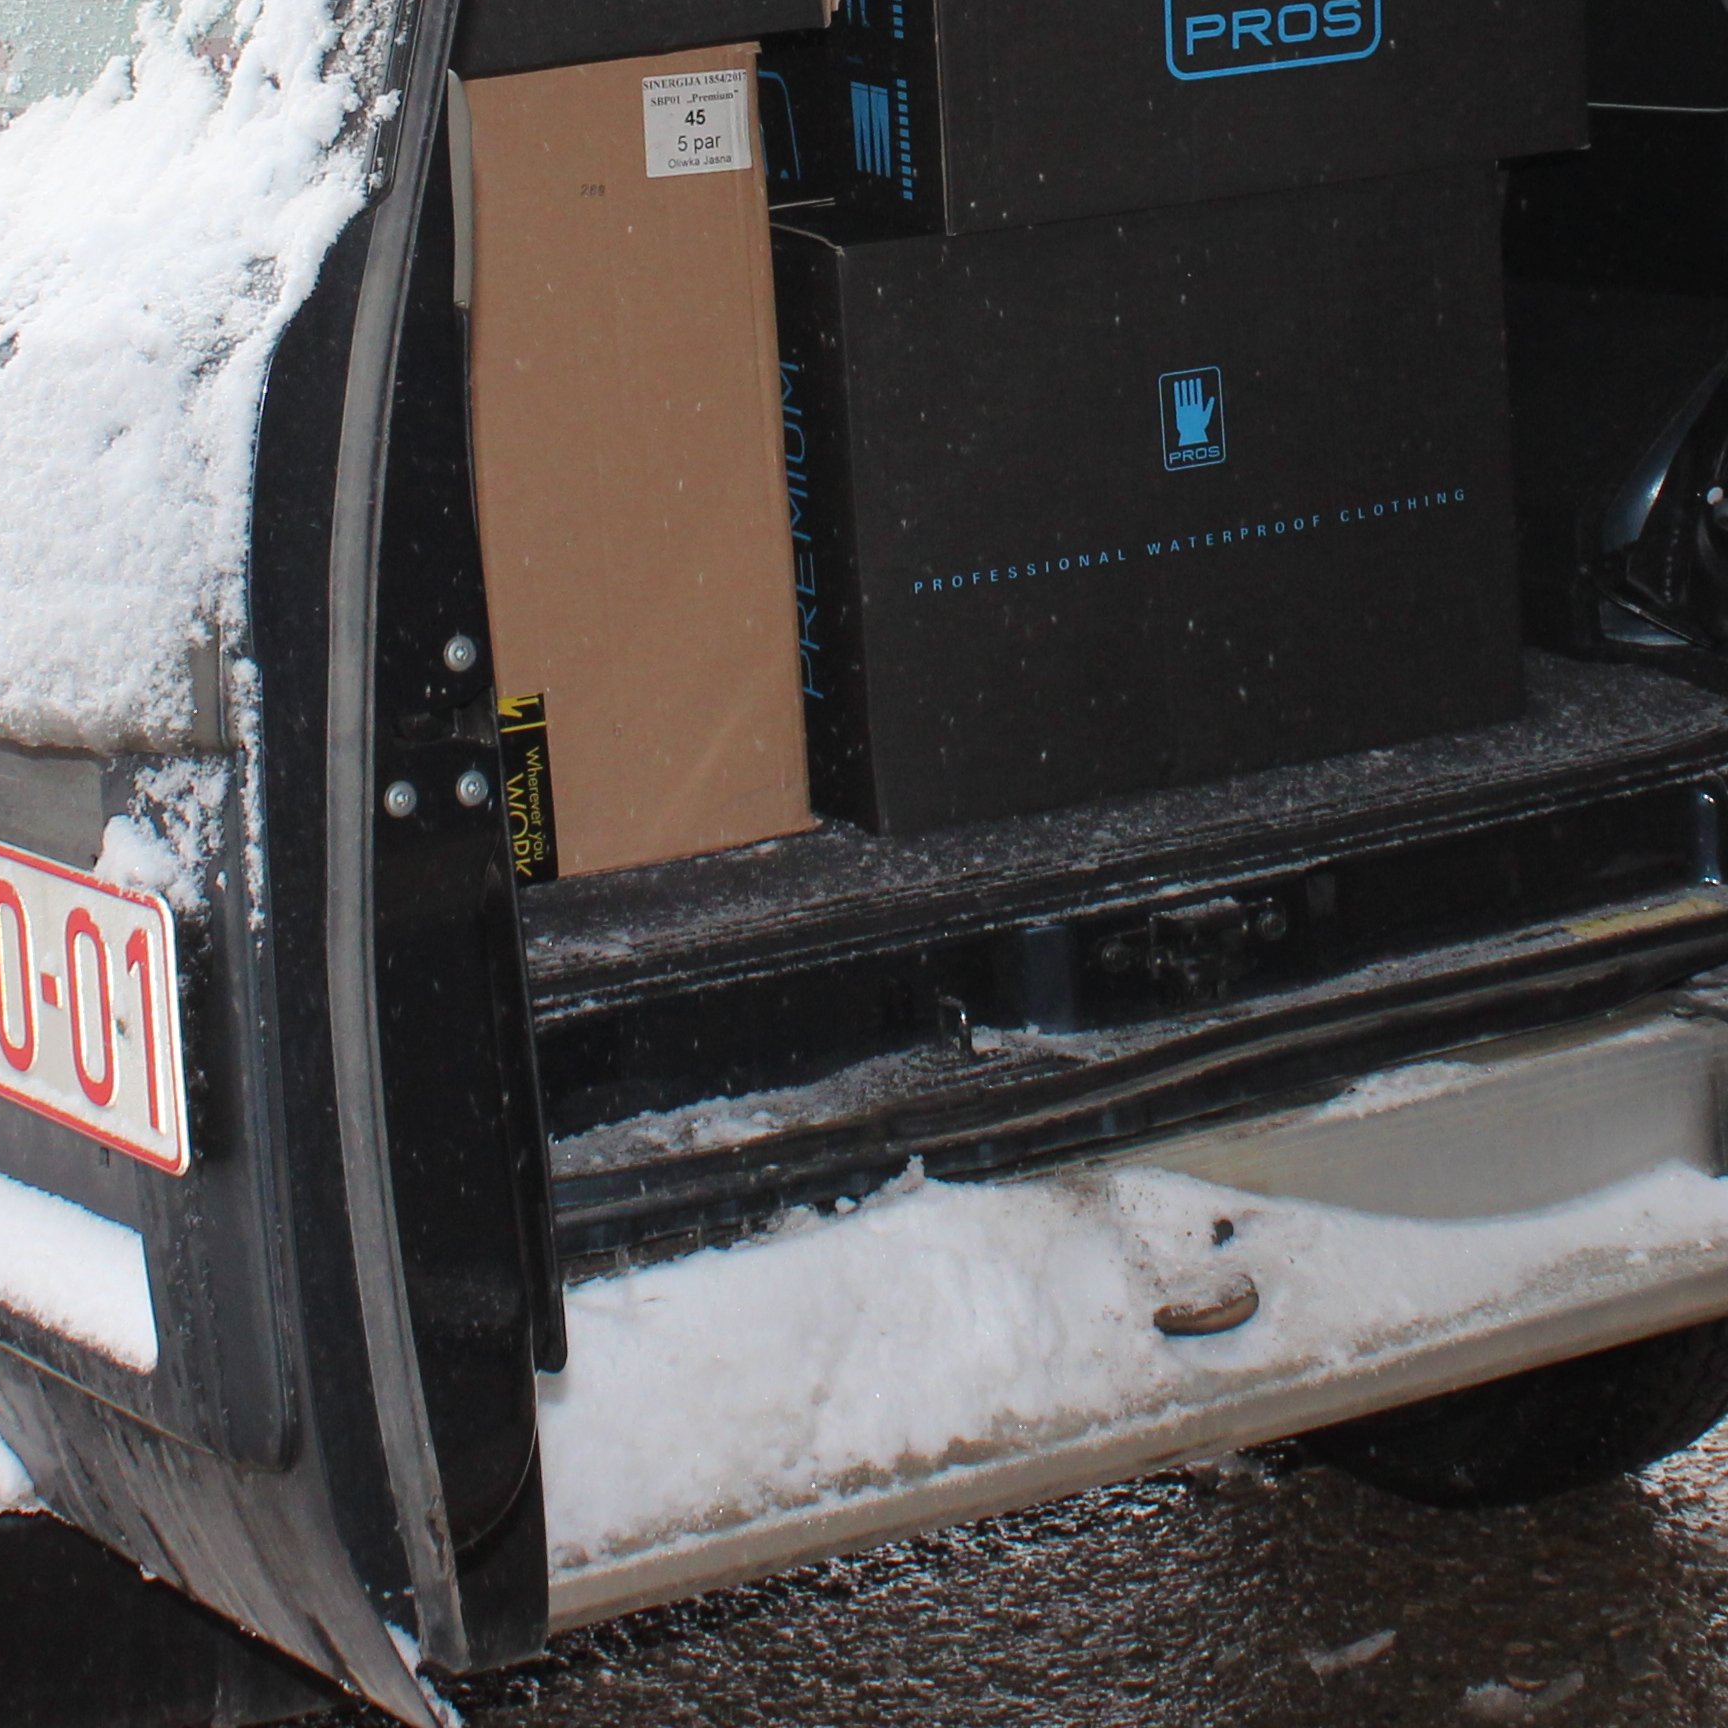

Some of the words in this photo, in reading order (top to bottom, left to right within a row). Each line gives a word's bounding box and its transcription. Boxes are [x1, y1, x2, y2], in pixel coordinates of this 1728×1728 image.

[643, 76, 701, 90] SINERGIJA
[651, 96, 681, 106] SBP01
[685, 109, 706, 125] 45
[678, 136, 688, 151] 5
[694, 136, 721, 153] par
[668, 158, 700, 169] Oliwka
[703, 155, 732, 166] Jasna
[1168, 444, 1221, 464] PROS
[914, 548, 1127, 594] PROFESSIONAL
[1147, 515, 1321, 556] WATERPROOF
[1340, 488, 1465, 522] CLOTHING
[525, 745, 544, 826] Wherever
[528, 832, 544, 861] you
